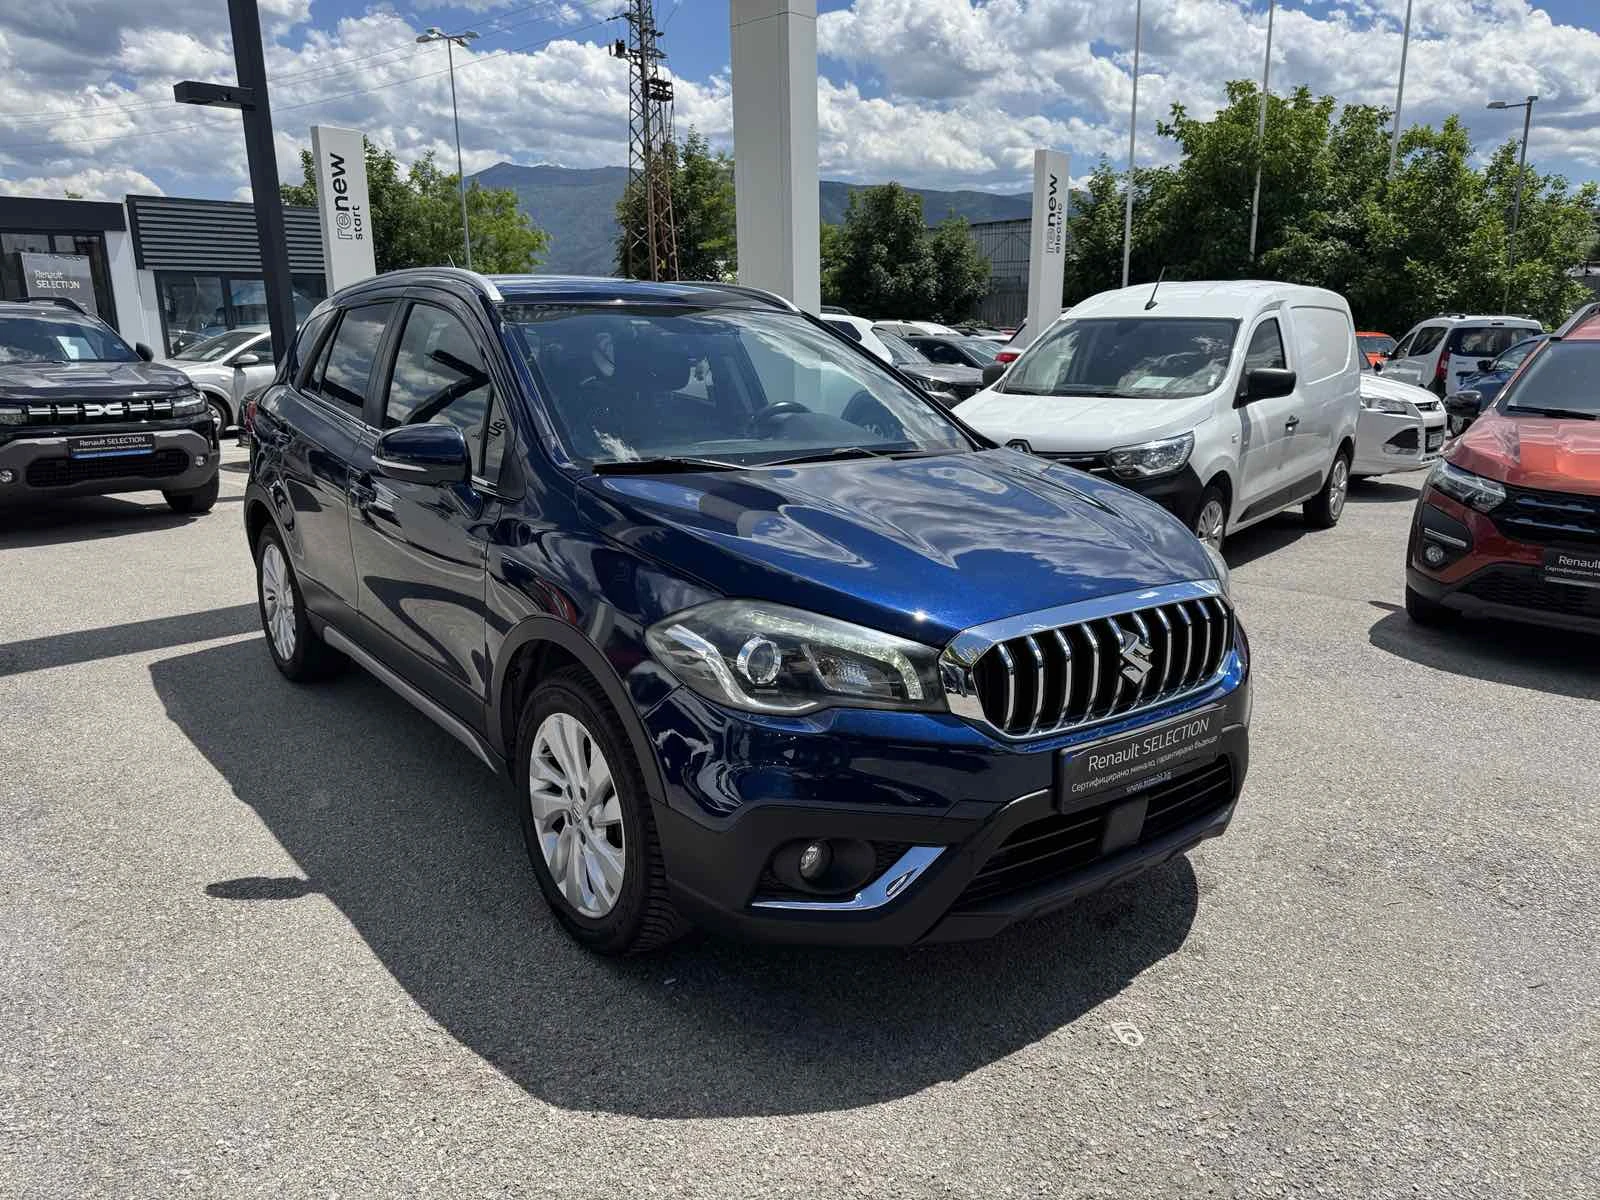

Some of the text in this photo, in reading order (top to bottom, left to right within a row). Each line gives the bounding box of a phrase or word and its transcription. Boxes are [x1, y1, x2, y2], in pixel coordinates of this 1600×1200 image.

[329, 152, 353, 240] renew
[1046, 173, 1058, 254] renew
[352, 205, 363, 240] start
[1055, 203, 1063, 254] electric
[34, 269, 63, 280] Renault
[35, 280, 80, 289] SELECTION
[79, 436, 145, 448] Renault SELECTION
[1088, 717, 1210, 773] Renault SELECTION
